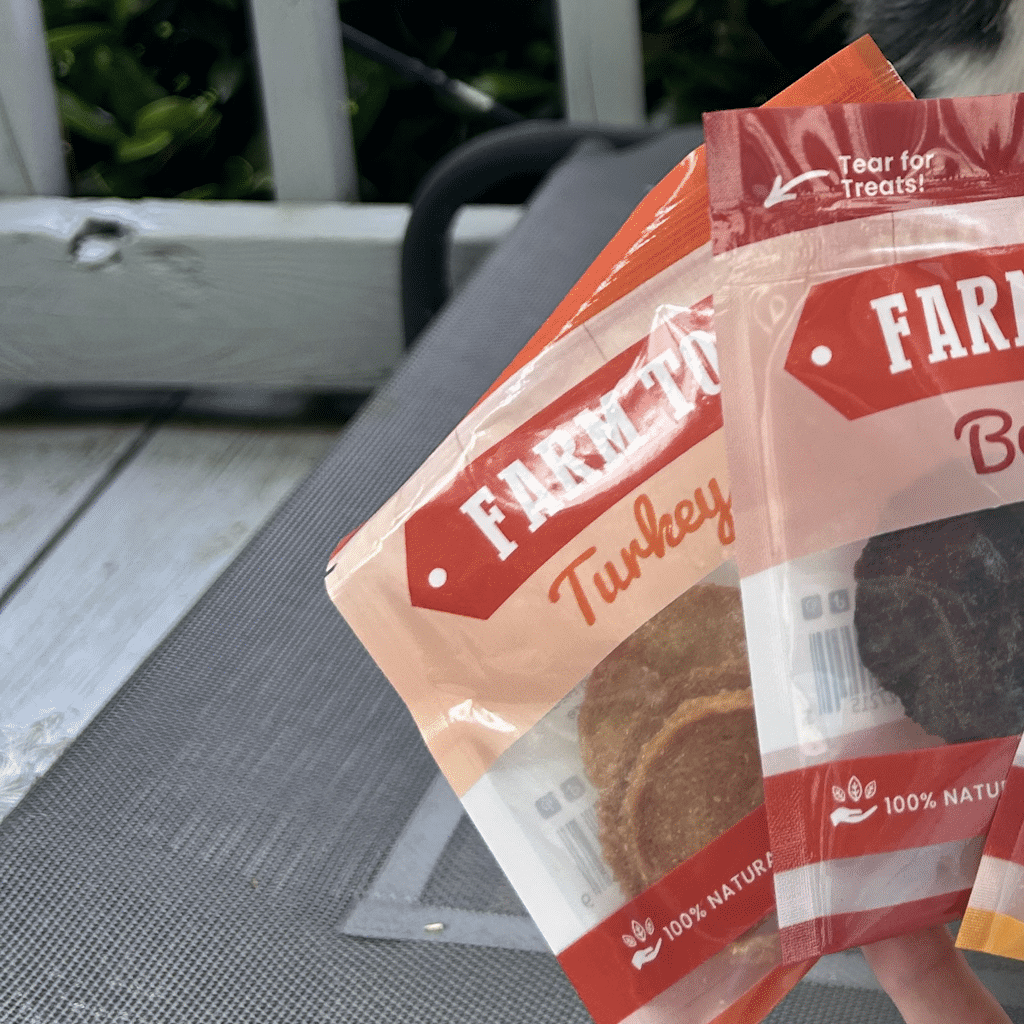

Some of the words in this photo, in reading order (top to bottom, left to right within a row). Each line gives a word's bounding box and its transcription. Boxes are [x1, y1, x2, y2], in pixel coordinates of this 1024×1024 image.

[839, 154, 894, 175] Tear
[900, 149, 935, 171] for
[840, 173, 925, 198] Treats!
[459, 388, 642, 562] FARM
[636, 329, 722, 421] TO
[548, 477, 736, 626] Turkey
[884, 791, 937, 815] 100%
[662, 903, 707, 941] 100%
